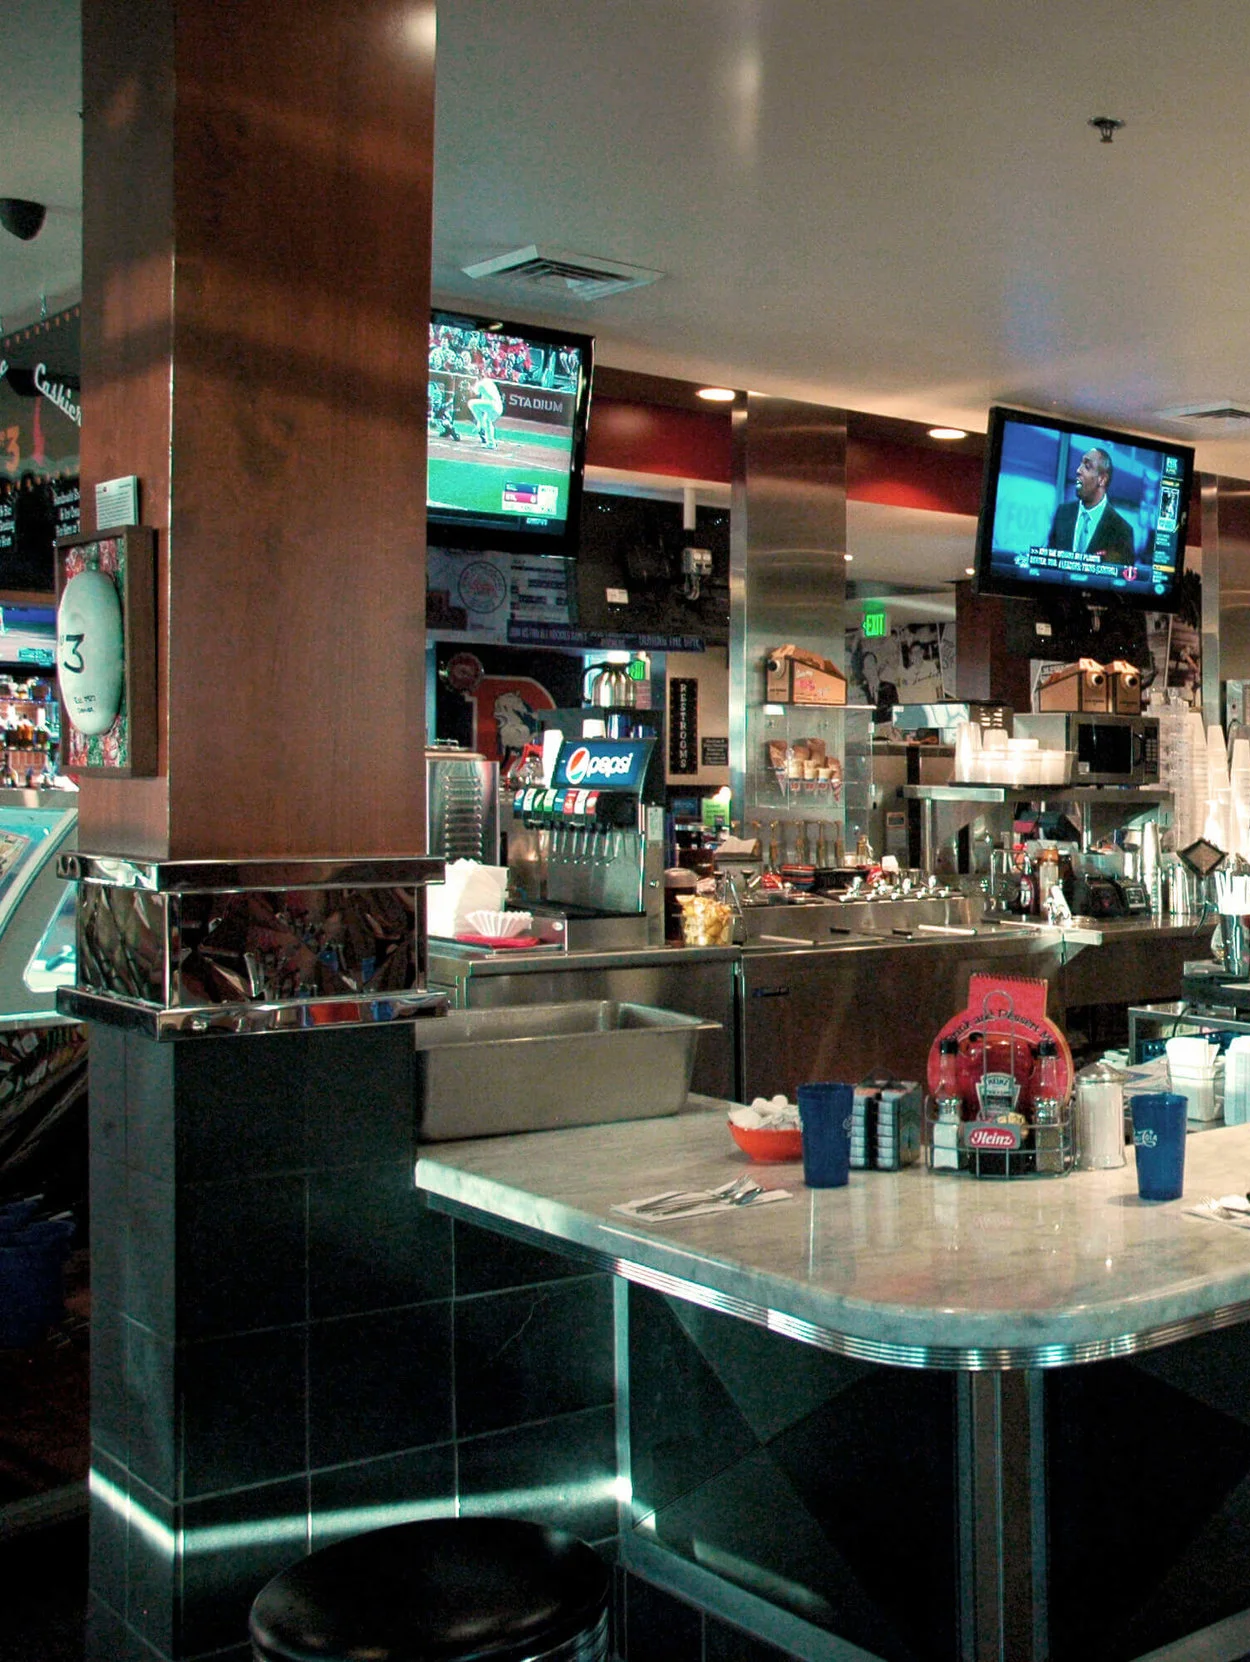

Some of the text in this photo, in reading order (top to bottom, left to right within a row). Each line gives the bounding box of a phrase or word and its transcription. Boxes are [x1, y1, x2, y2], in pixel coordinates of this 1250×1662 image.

[509, 394, 563, 413] STADIUM
[866, 614, 884, 636] EXIT
[63, 633, 85, 674] 3
[679, 683, 688, 769] RESTROOMS
[586, 752, 634, 778] pepsi
[971, 1130, 1013, 1146] Heinz
